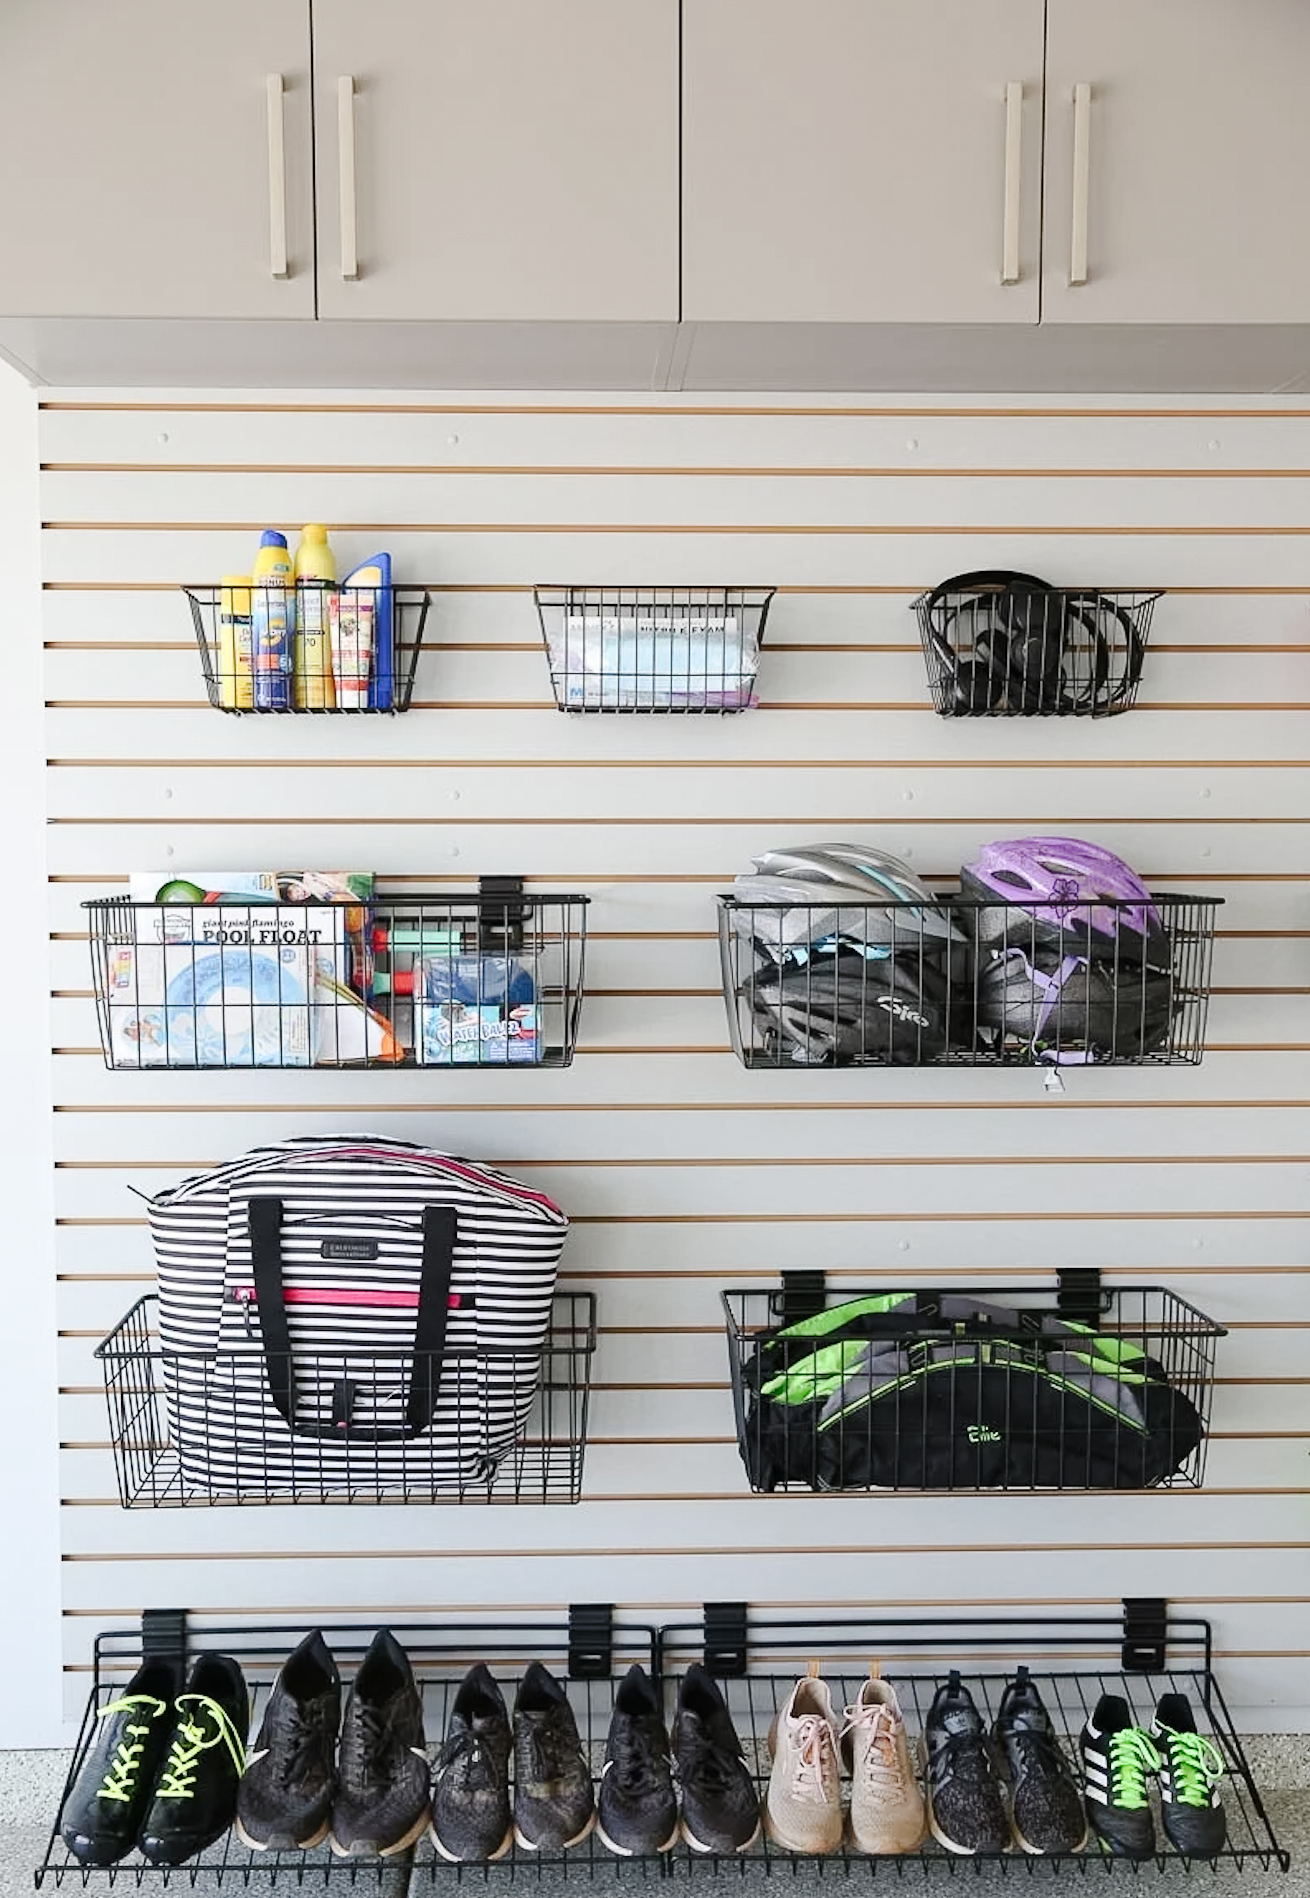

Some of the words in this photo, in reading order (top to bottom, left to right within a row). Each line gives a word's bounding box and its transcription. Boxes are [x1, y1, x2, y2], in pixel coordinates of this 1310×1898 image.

[203, 919, 227, 929] giant
[252, 919, 295, 928] flamingo
[203, 930, 254, 943] POOL
[260, 930, 322, 943] FLOAT
